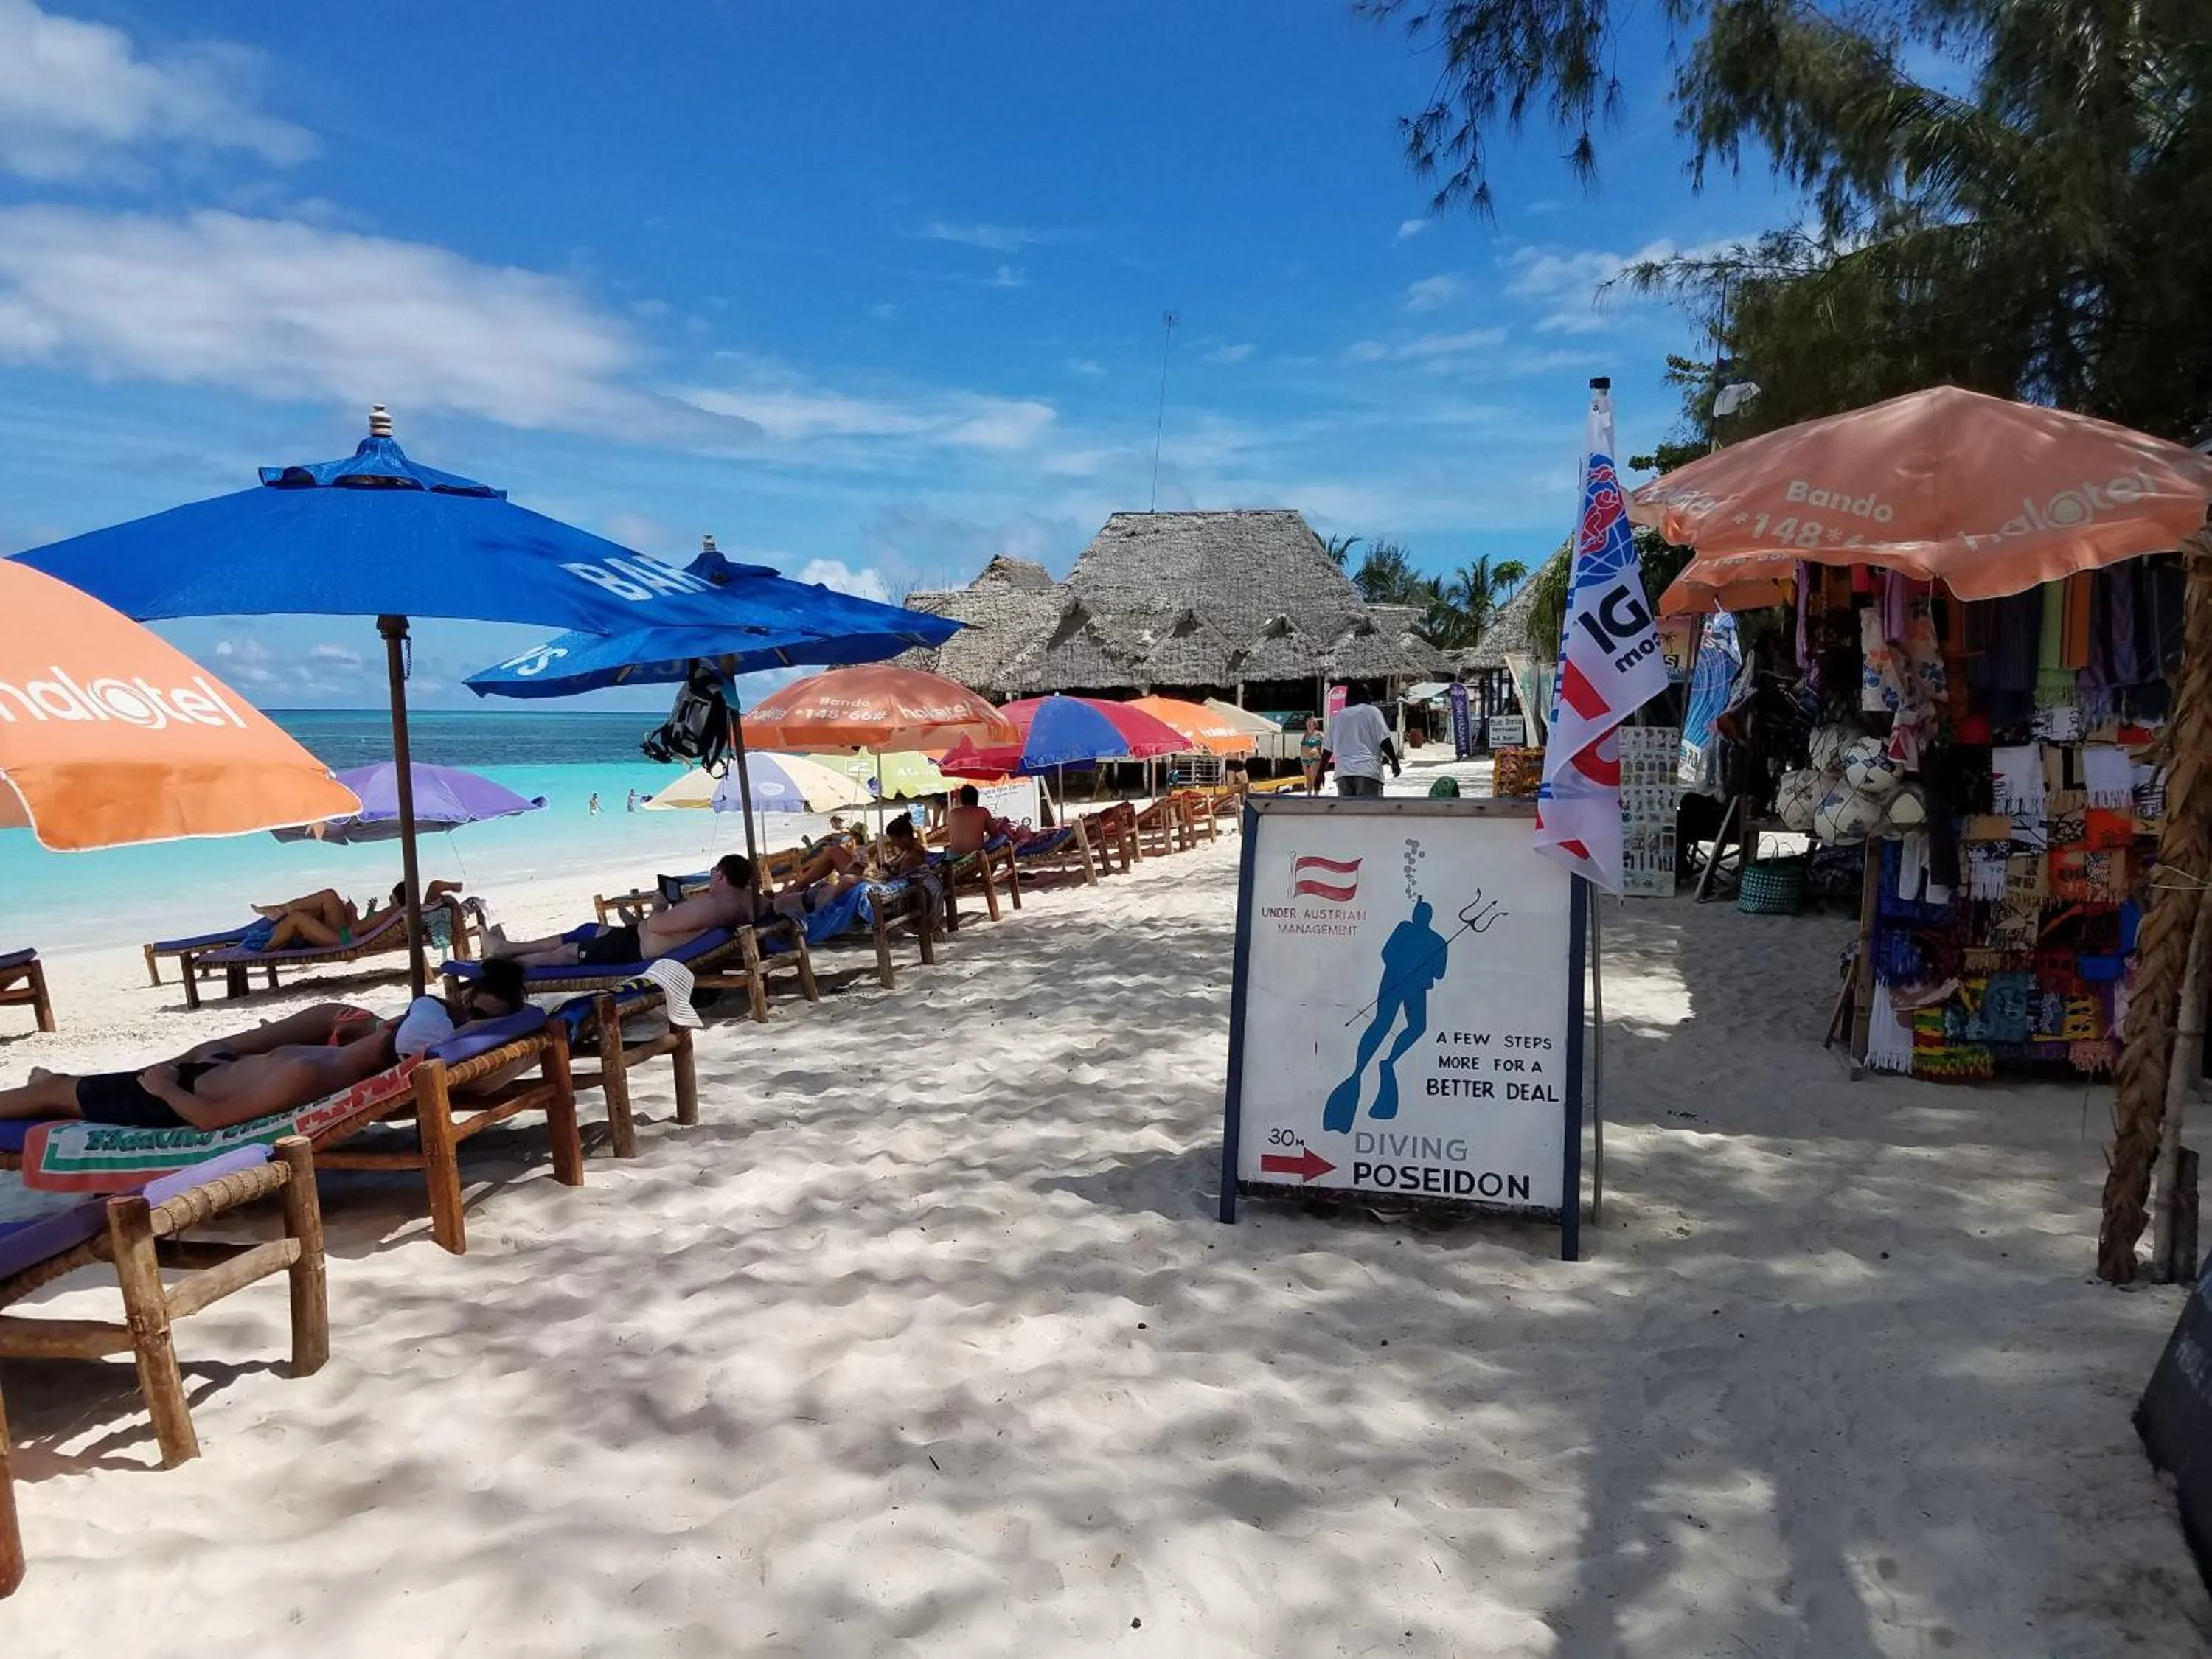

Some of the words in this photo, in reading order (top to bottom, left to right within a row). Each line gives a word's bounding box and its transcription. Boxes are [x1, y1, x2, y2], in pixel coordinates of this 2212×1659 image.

[1784, 479, 1894, 522] Bando
[818, 697, 872, 708] Bando
[1262, 908, 1297, 919] UNDER
[1303, 908, 1367, 921] AUSTRIAN
[1278, 923, 1357, 936] MANAGEMENT
[1436, 1032, 1447, 1044] A
[1453, 1032, 1490, 1046] FEW
[1503, 1035, 1552, 1050] STEPS
[1439, 1055, 1480, 1070] MORE
[1493, 1058, 1525, 1072] FOR
[1531, 1061, 1543, 1073] A
[1426, 1078, 1495, 1099] BETTER
[1506, 1082, 1559, 1102] DEAL
[1354, 1131, 1467, 1162] DIVING
[1353, 1161, 1531, 1200] POSEIDON
